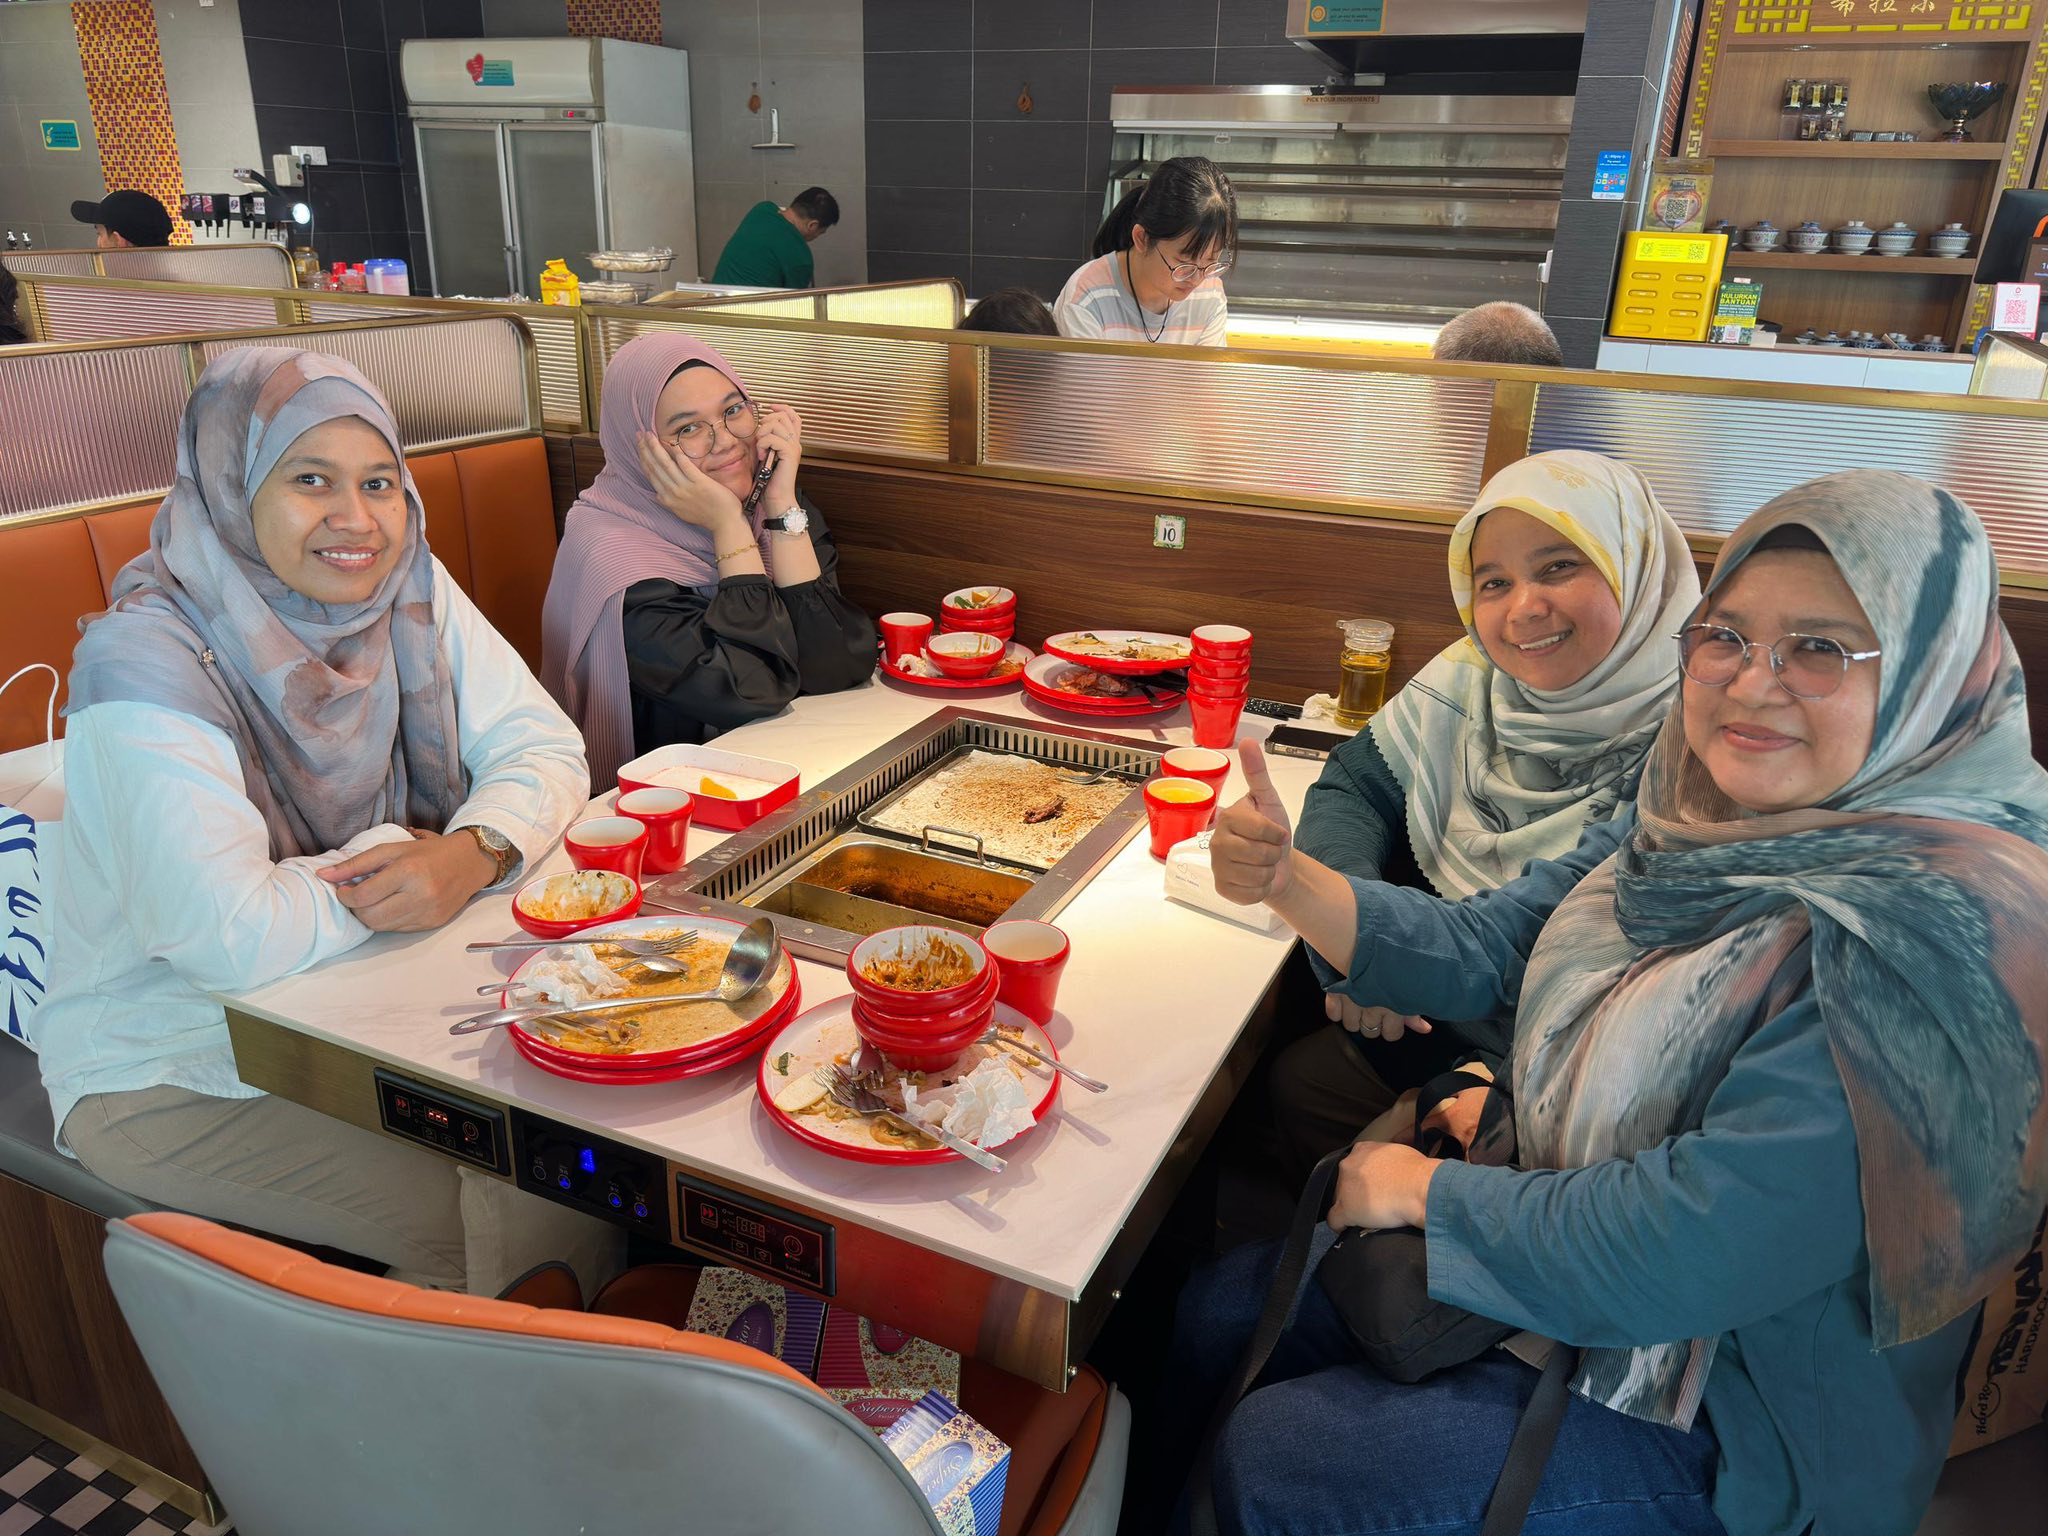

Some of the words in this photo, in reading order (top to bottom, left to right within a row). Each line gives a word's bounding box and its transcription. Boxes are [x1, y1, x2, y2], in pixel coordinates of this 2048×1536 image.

[1719, 298, 1757, 306] BANTUAN
[1721, 292, 1758, 301] HULURKAN
[1162, 527, 1176, 542] 10
[2014, 1288, 2048, 1374] HARDROC
[851, 1401, 911, 1420] Superio
[897, 1421, 911, 1434] 70
